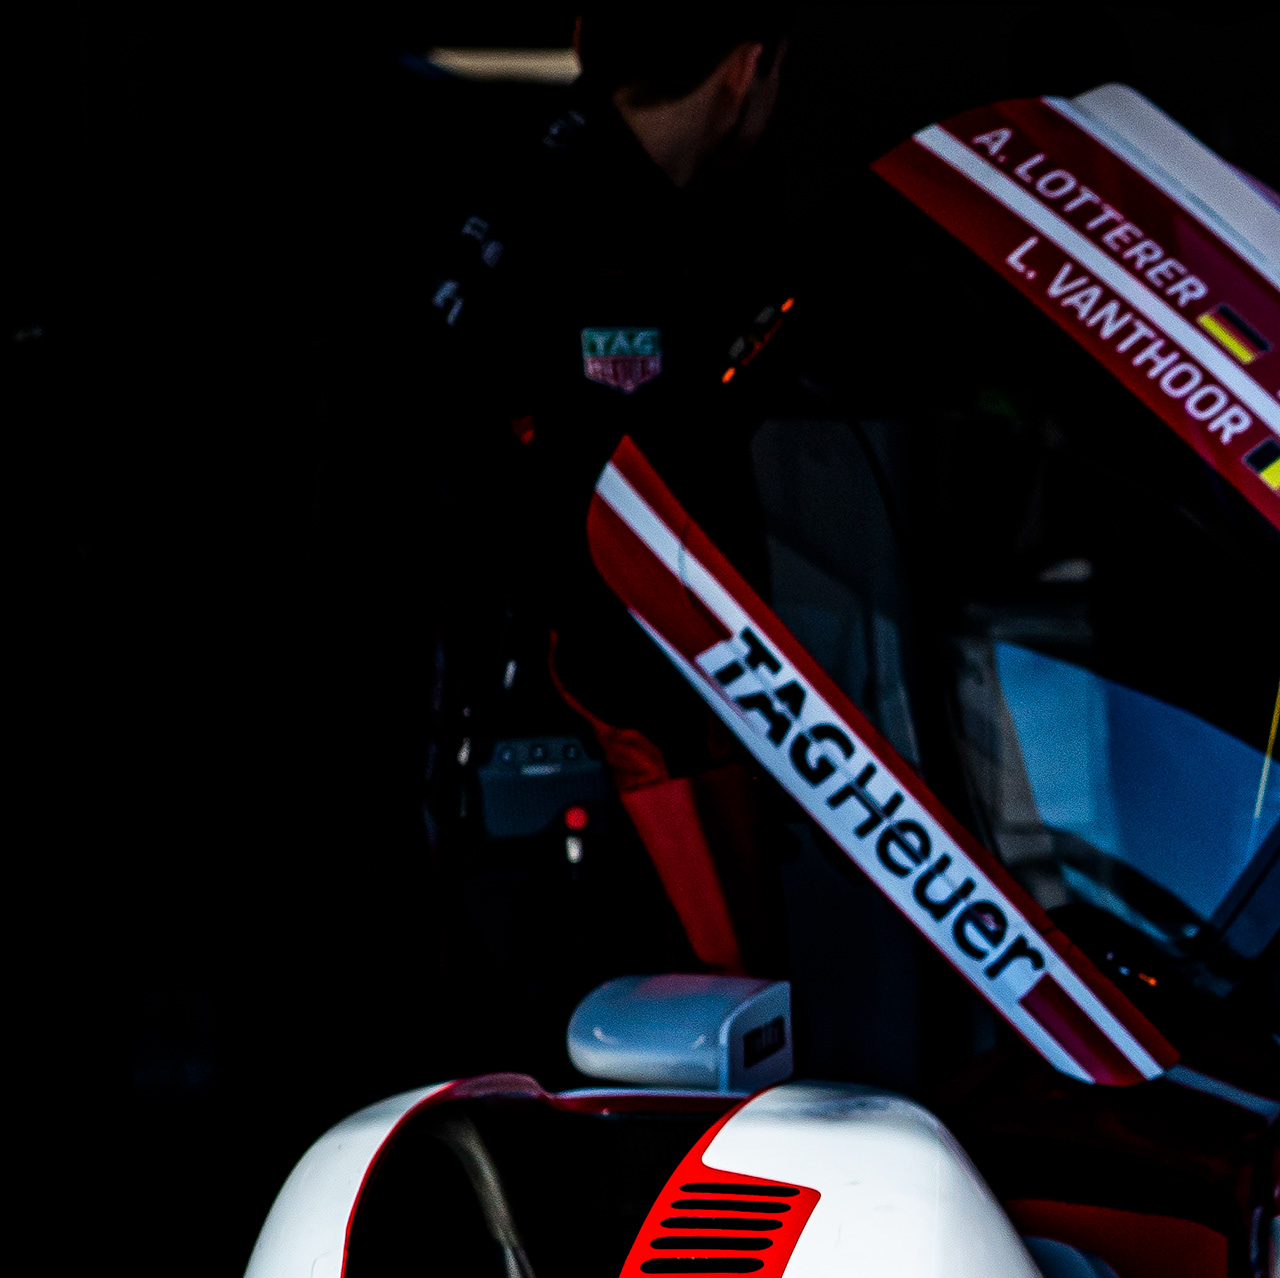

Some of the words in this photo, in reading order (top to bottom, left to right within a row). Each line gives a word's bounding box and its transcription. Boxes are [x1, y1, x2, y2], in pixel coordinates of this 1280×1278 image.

[972, 127, 1012, 163] A.
[1014, 154, 1209, 308] LOTTERER
[592, 330, 657, 355] TAG
[1005, 236, 1038, 281] L.
[1046, 262, 1252, 446] VANTHOOR
